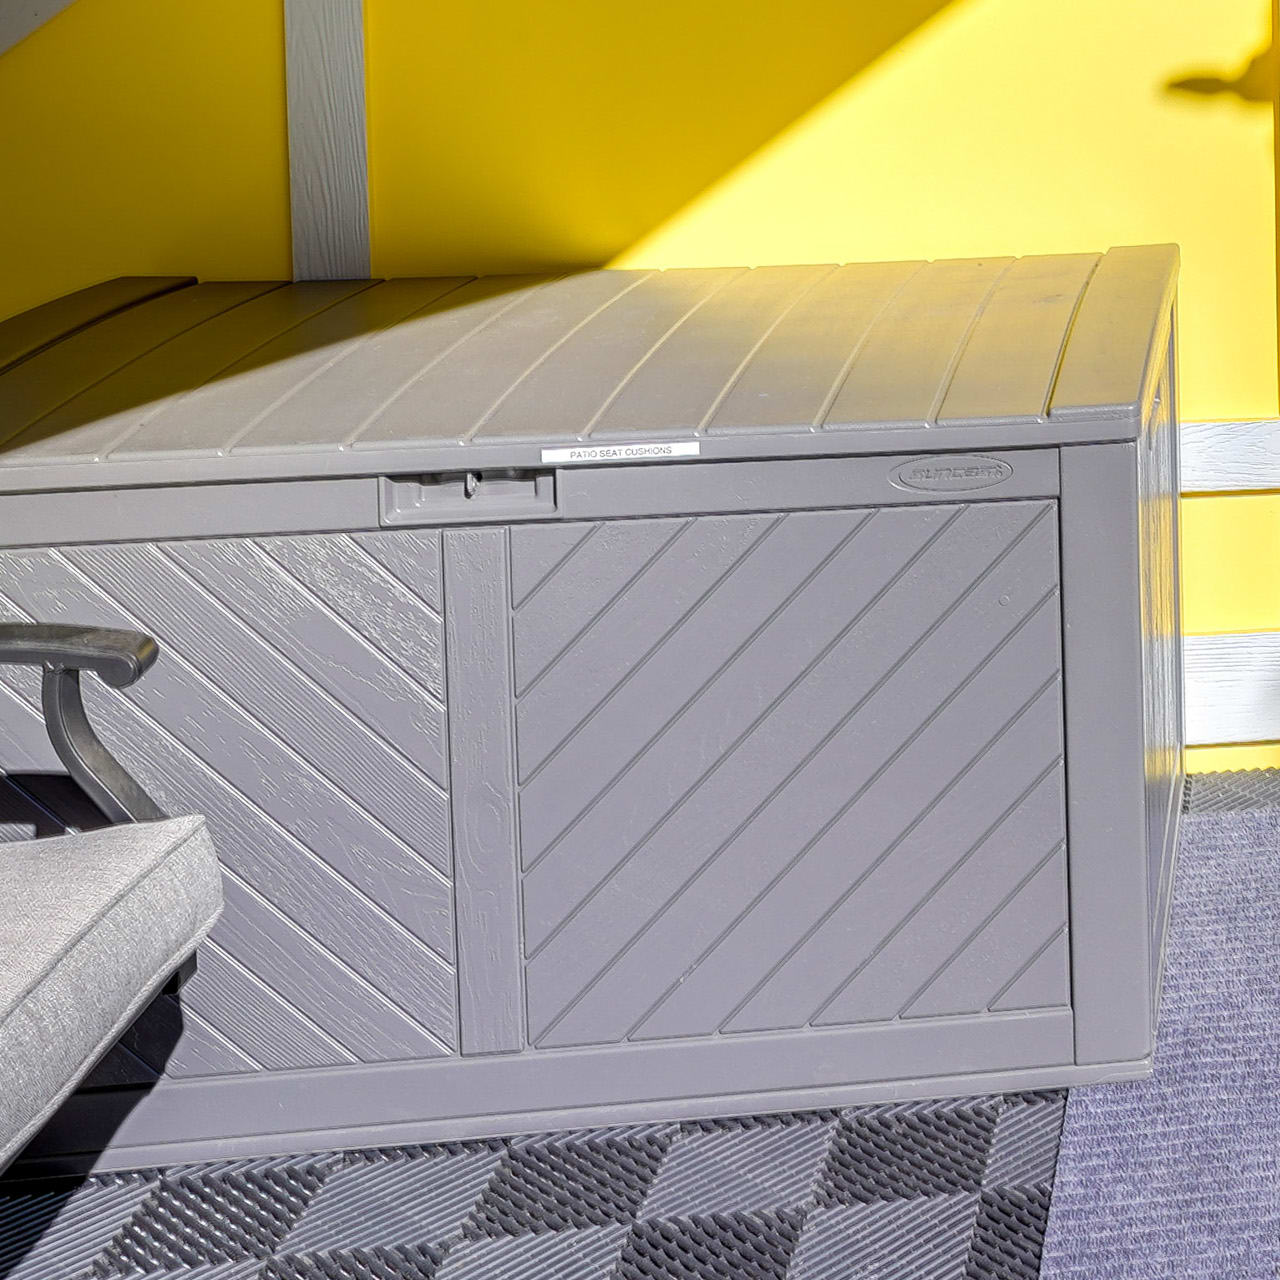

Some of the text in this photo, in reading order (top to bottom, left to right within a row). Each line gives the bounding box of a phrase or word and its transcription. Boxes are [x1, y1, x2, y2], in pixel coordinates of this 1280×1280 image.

[570, 446, 672, 459] PATIO SEAT CUSHIONS
